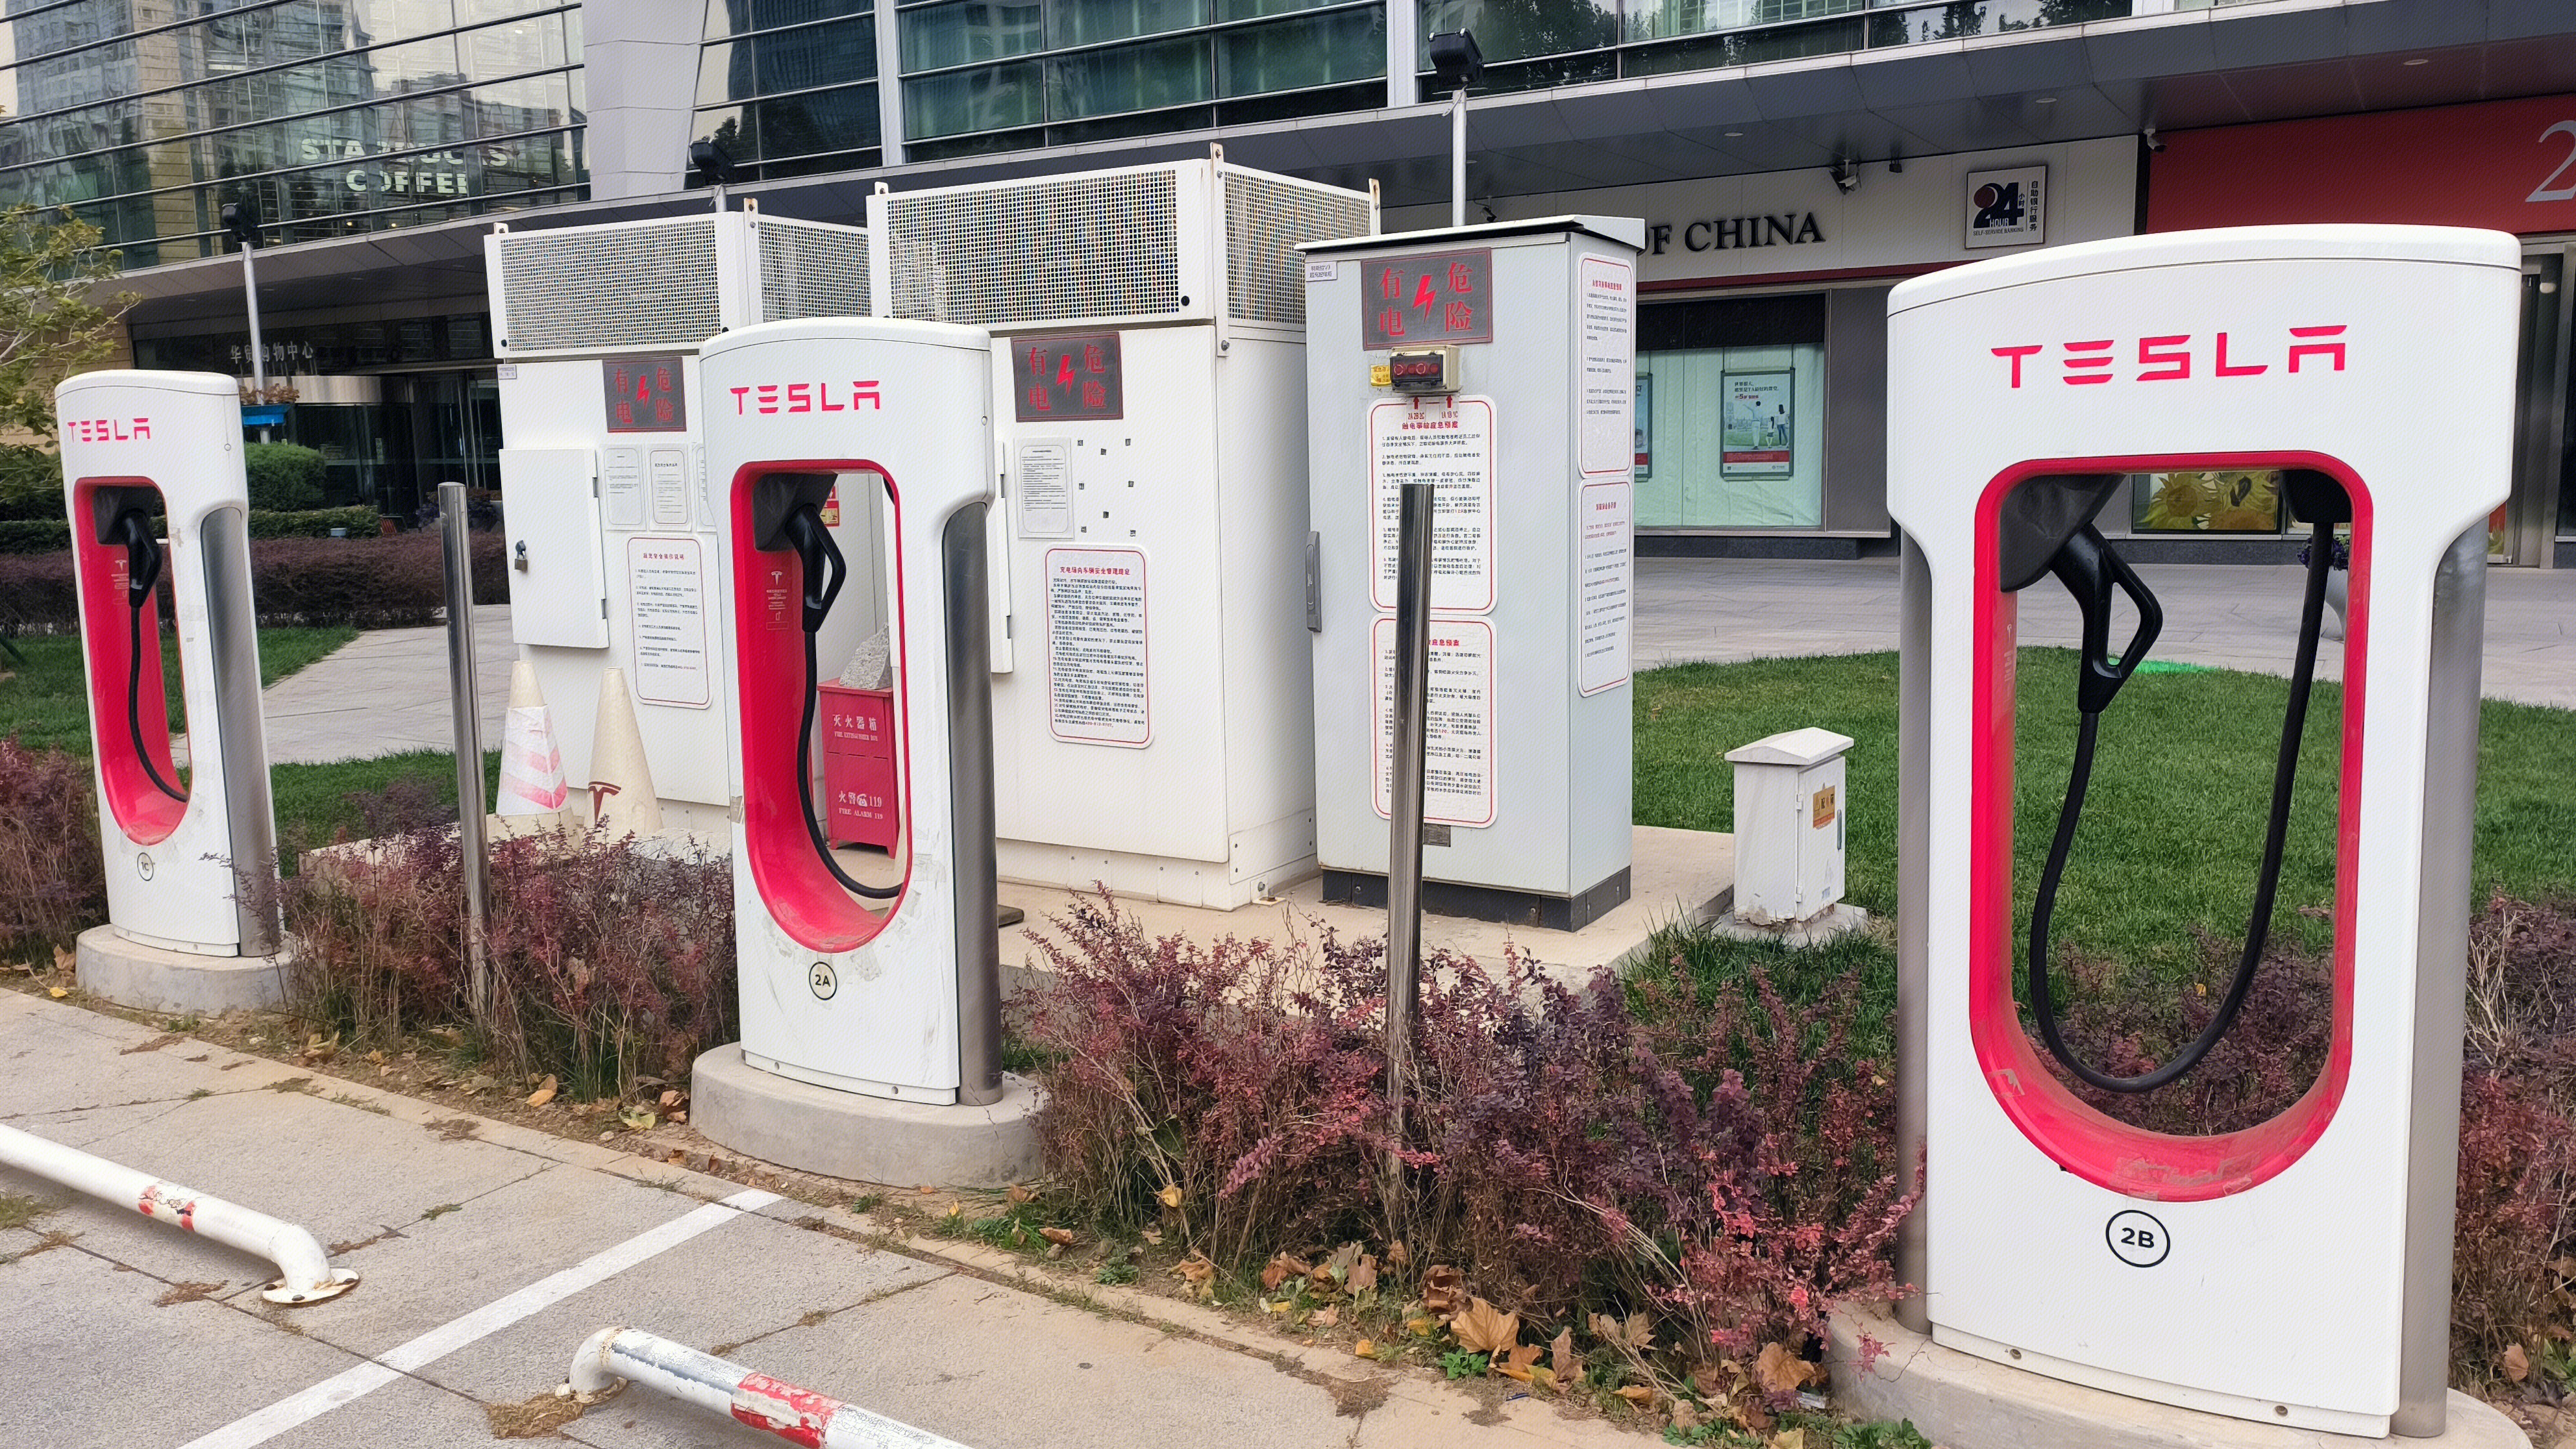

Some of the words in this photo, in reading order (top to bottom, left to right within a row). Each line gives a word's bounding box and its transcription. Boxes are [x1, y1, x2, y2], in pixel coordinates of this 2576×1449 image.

[2525, 119, 2576, 203] 2
[1974, 182, 2024, 229] 24
[1990, 218, 2009, 227] HOUR
[2029, 181, 2038, 231] 自助银行服务
[1637, 225, 1672, 256] F
[1685, 212, 1826, 253] CHINA
[1378, 267, 1405, 336] 有电
[1445, 262, 1473, 332] 危险
[1991, 325, 2347, 388] TESLA
[1026, 347, 1050, 410] 有电
[1083, 344, 1107, 409] 危险
[613, 368, 632, 423] 有电
[655, 367, 675, 422] 危险
[730, 380, 880, 415] TESLA
[68, 418, 150, 443] TESLA
[832, 714, 877, 732] 灭火器箱
[839, 791, 856, 805] 火警
[869, 796, 882, 808] 119
[854, 810, 872, 819] ALARM
[141, 861, 149, 871] 1C
[815, 974, 831, 987] 2A
[2121, 1228, 2155, 1248] 2B
